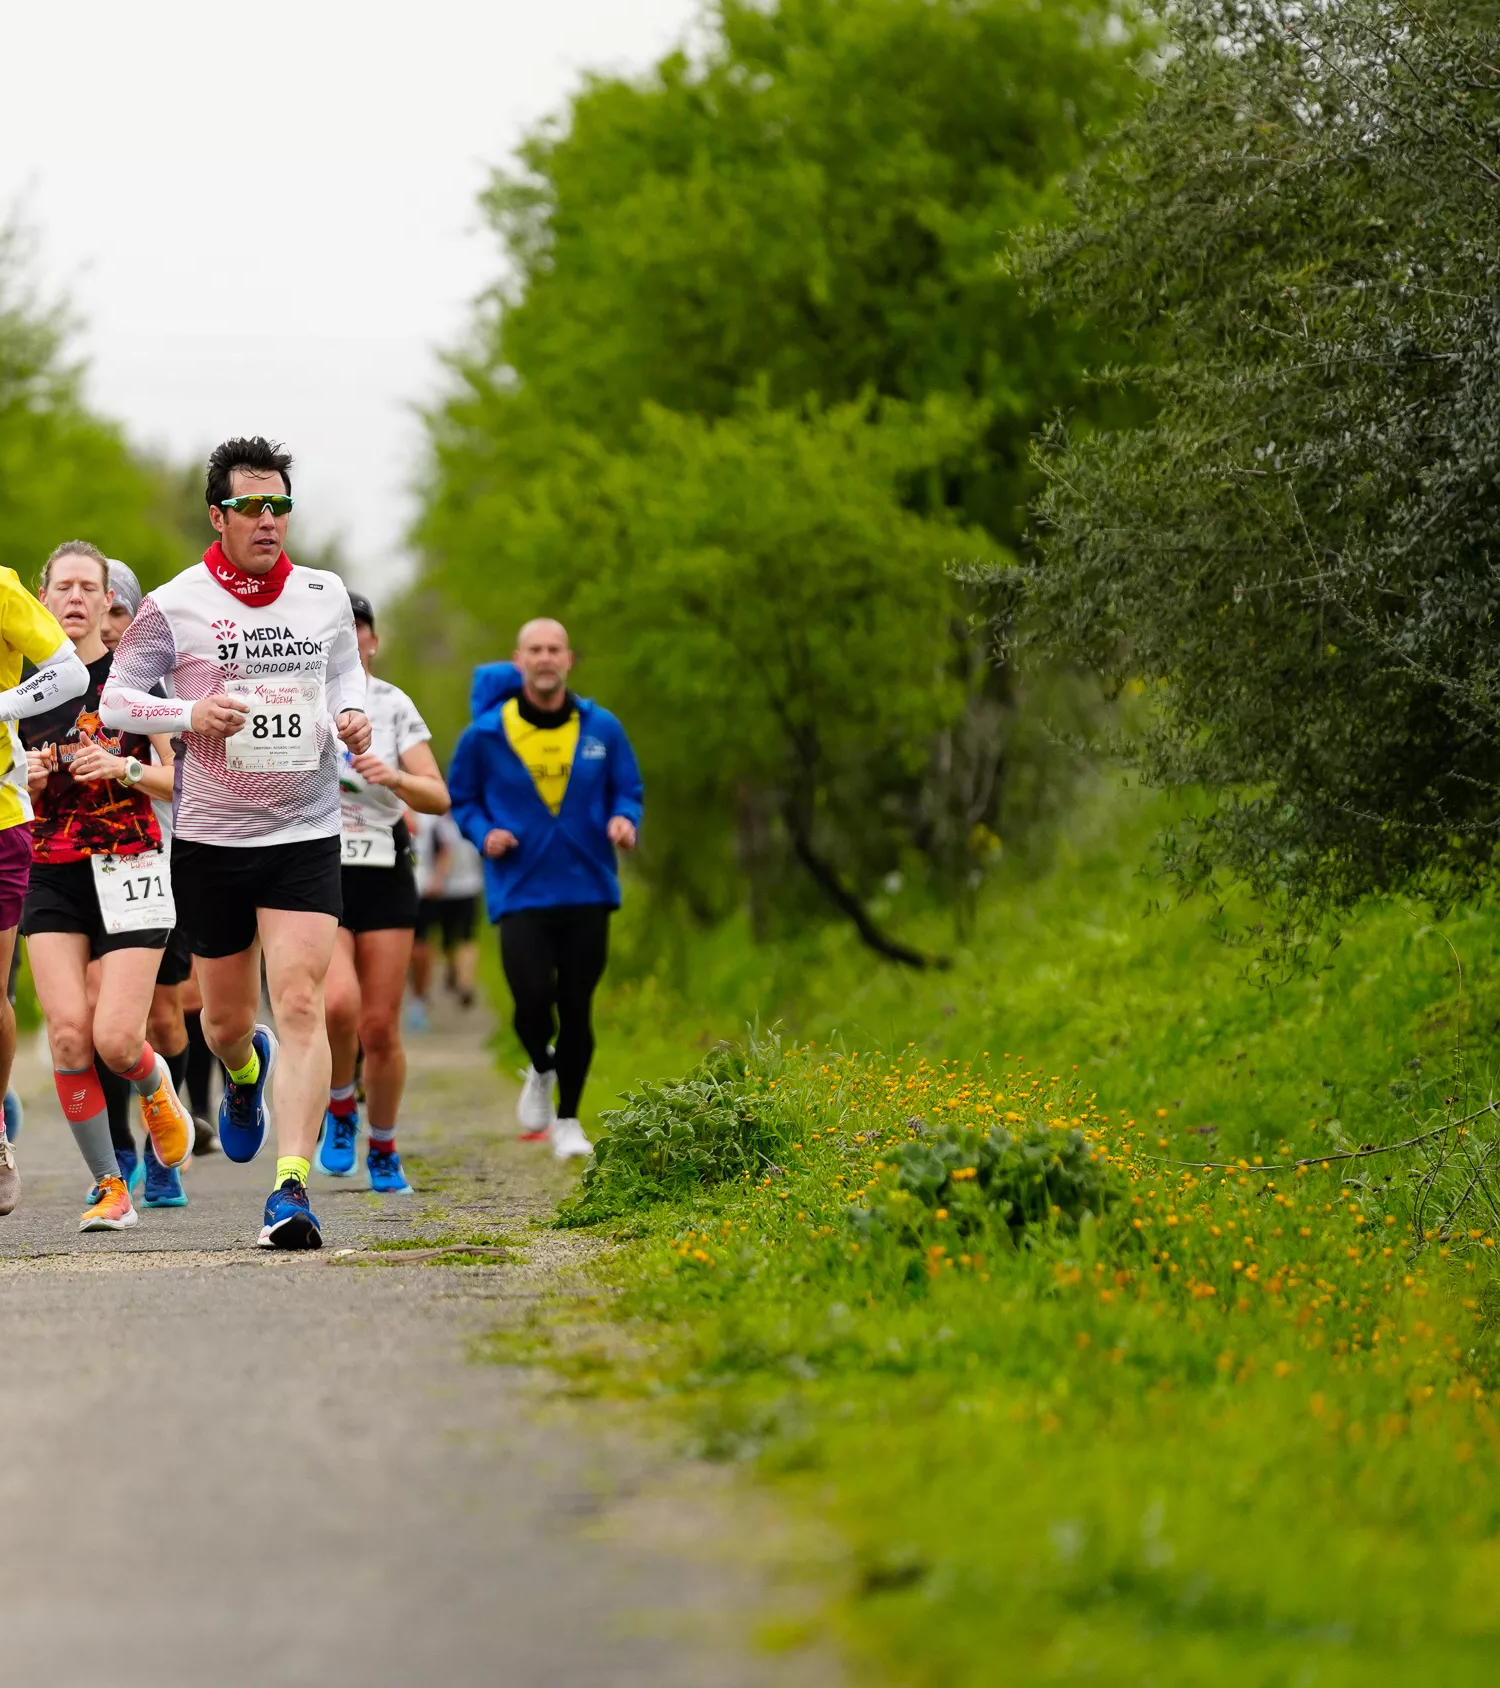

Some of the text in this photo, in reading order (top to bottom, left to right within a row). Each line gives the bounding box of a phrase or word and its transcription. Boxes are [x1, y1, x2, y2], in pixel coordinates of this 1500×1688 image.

[242, 626, 295, 642] MEDIA
[217, 637, 322, 661] 37 MARATÓN
[245, 662, 301, 674] CÓRDOBA
[265, 695, 296, 704] LUCENA
[252, 713, 302, 739] 818
[341, 840, 374, 858] 57
[123, 875, 165, 902] 171
